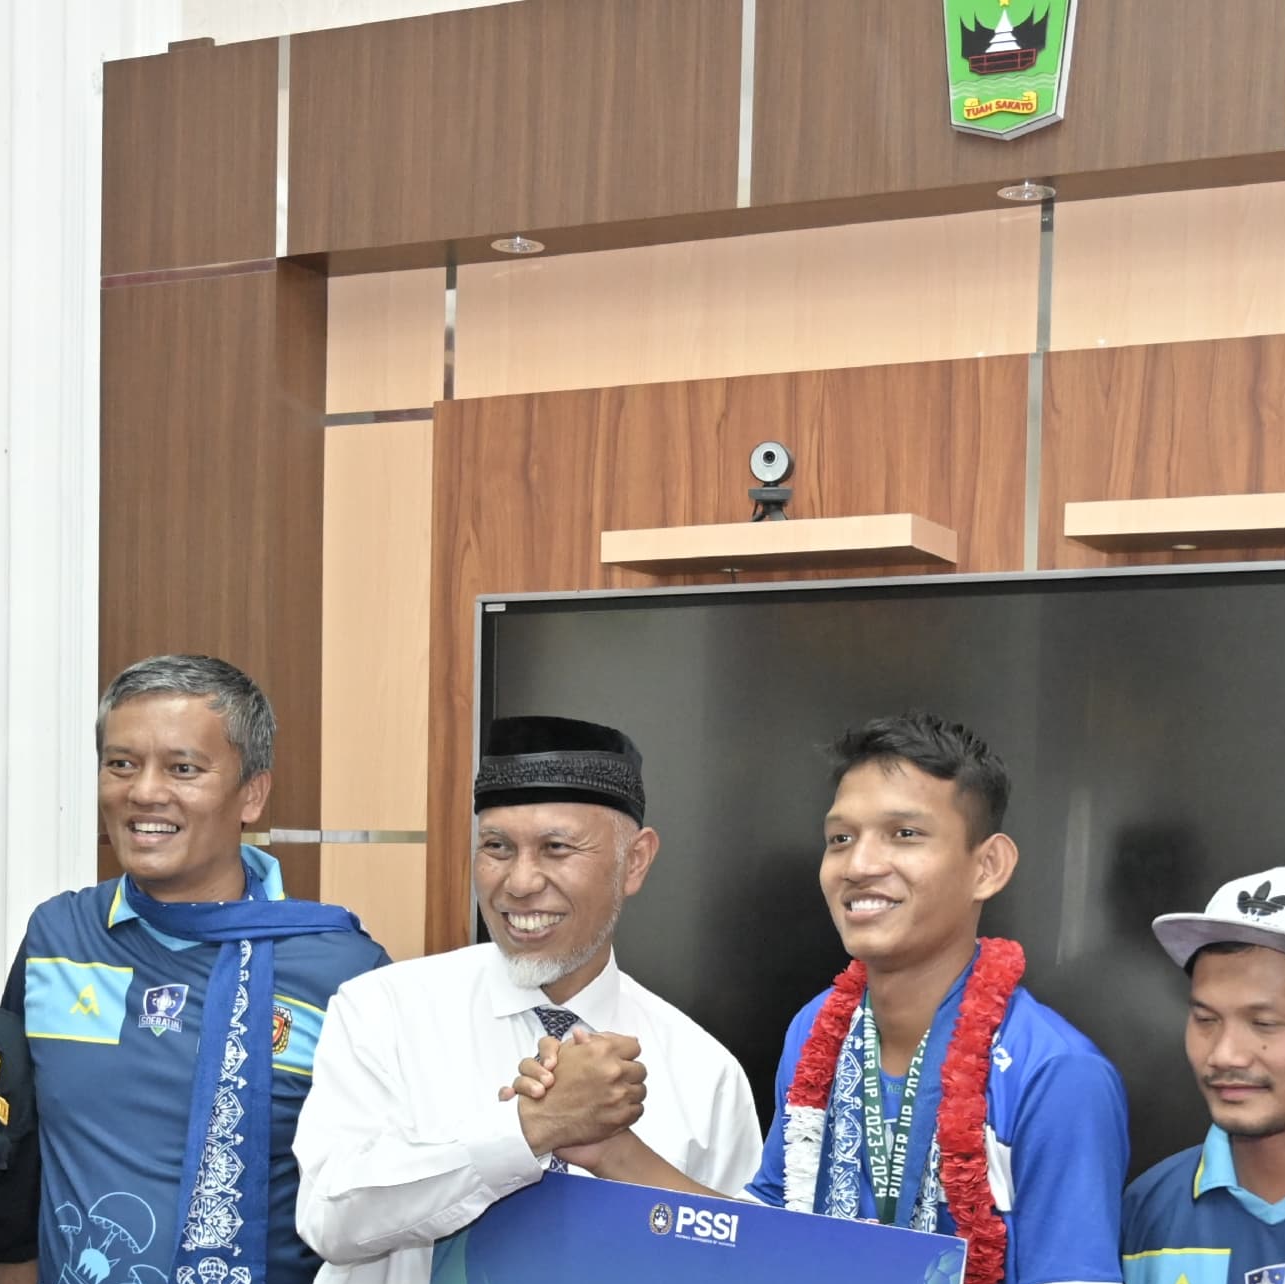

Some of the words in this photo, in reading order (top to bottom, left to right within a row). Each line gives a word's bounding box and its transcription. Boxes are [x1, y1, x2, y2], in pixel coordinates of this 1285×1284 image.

[965, 103, 992, 117] TUAH
[996, 100, 1033, 111] SAKATO
[141, 1015, 181, 1030] SOERATIN
[864, 1076, 878, 1098] UP
[865, 1105, 889, 1198] 2023-2024
[676, 1206, 738, 1242] PSSI
